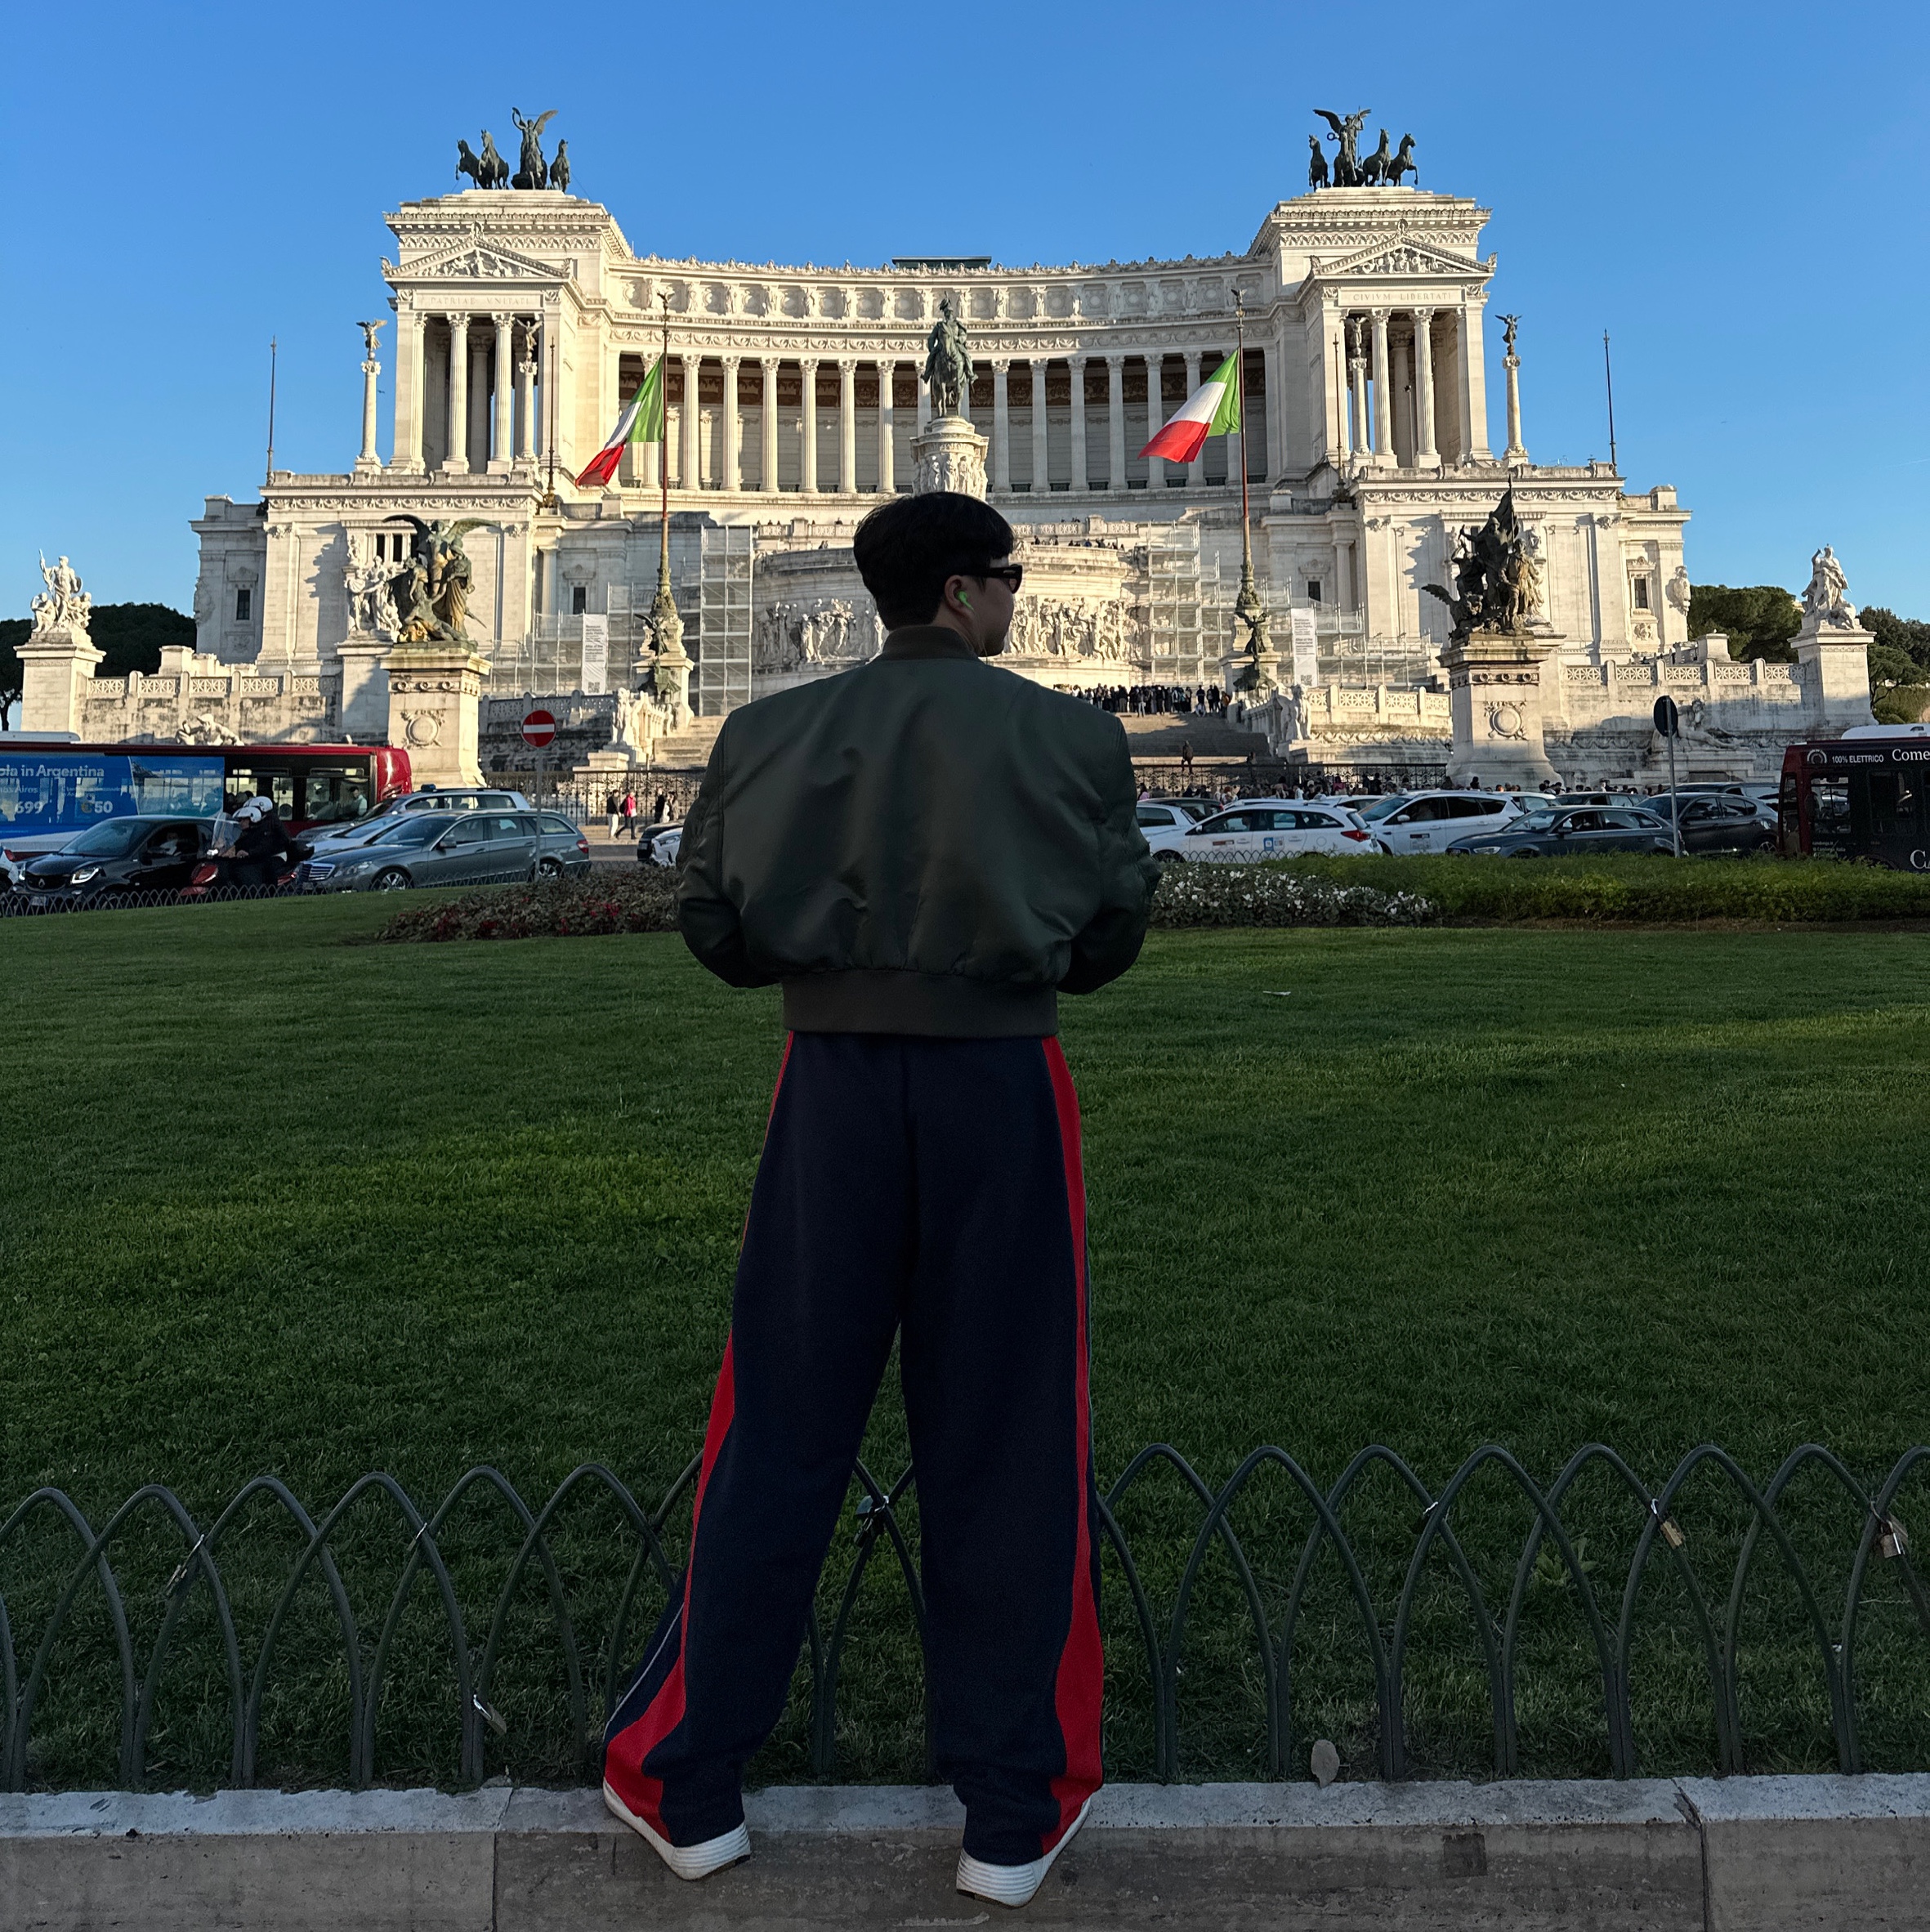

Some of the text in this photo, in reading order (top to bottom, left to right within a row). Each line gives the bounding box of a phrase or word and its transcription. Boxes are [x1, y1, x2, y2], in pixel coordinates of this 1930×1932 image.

[431, 297, 529, 305] PATRIAE VNITATI
[1400, 293, 1451, 301] LIBERTATI
[1831, 754, 1884, 763] 100% ELETTRICO
[1892, 748, 1930, 762] Come
[21, 764, 34, 777] in
[35, 764, 105, 780] Argentina
